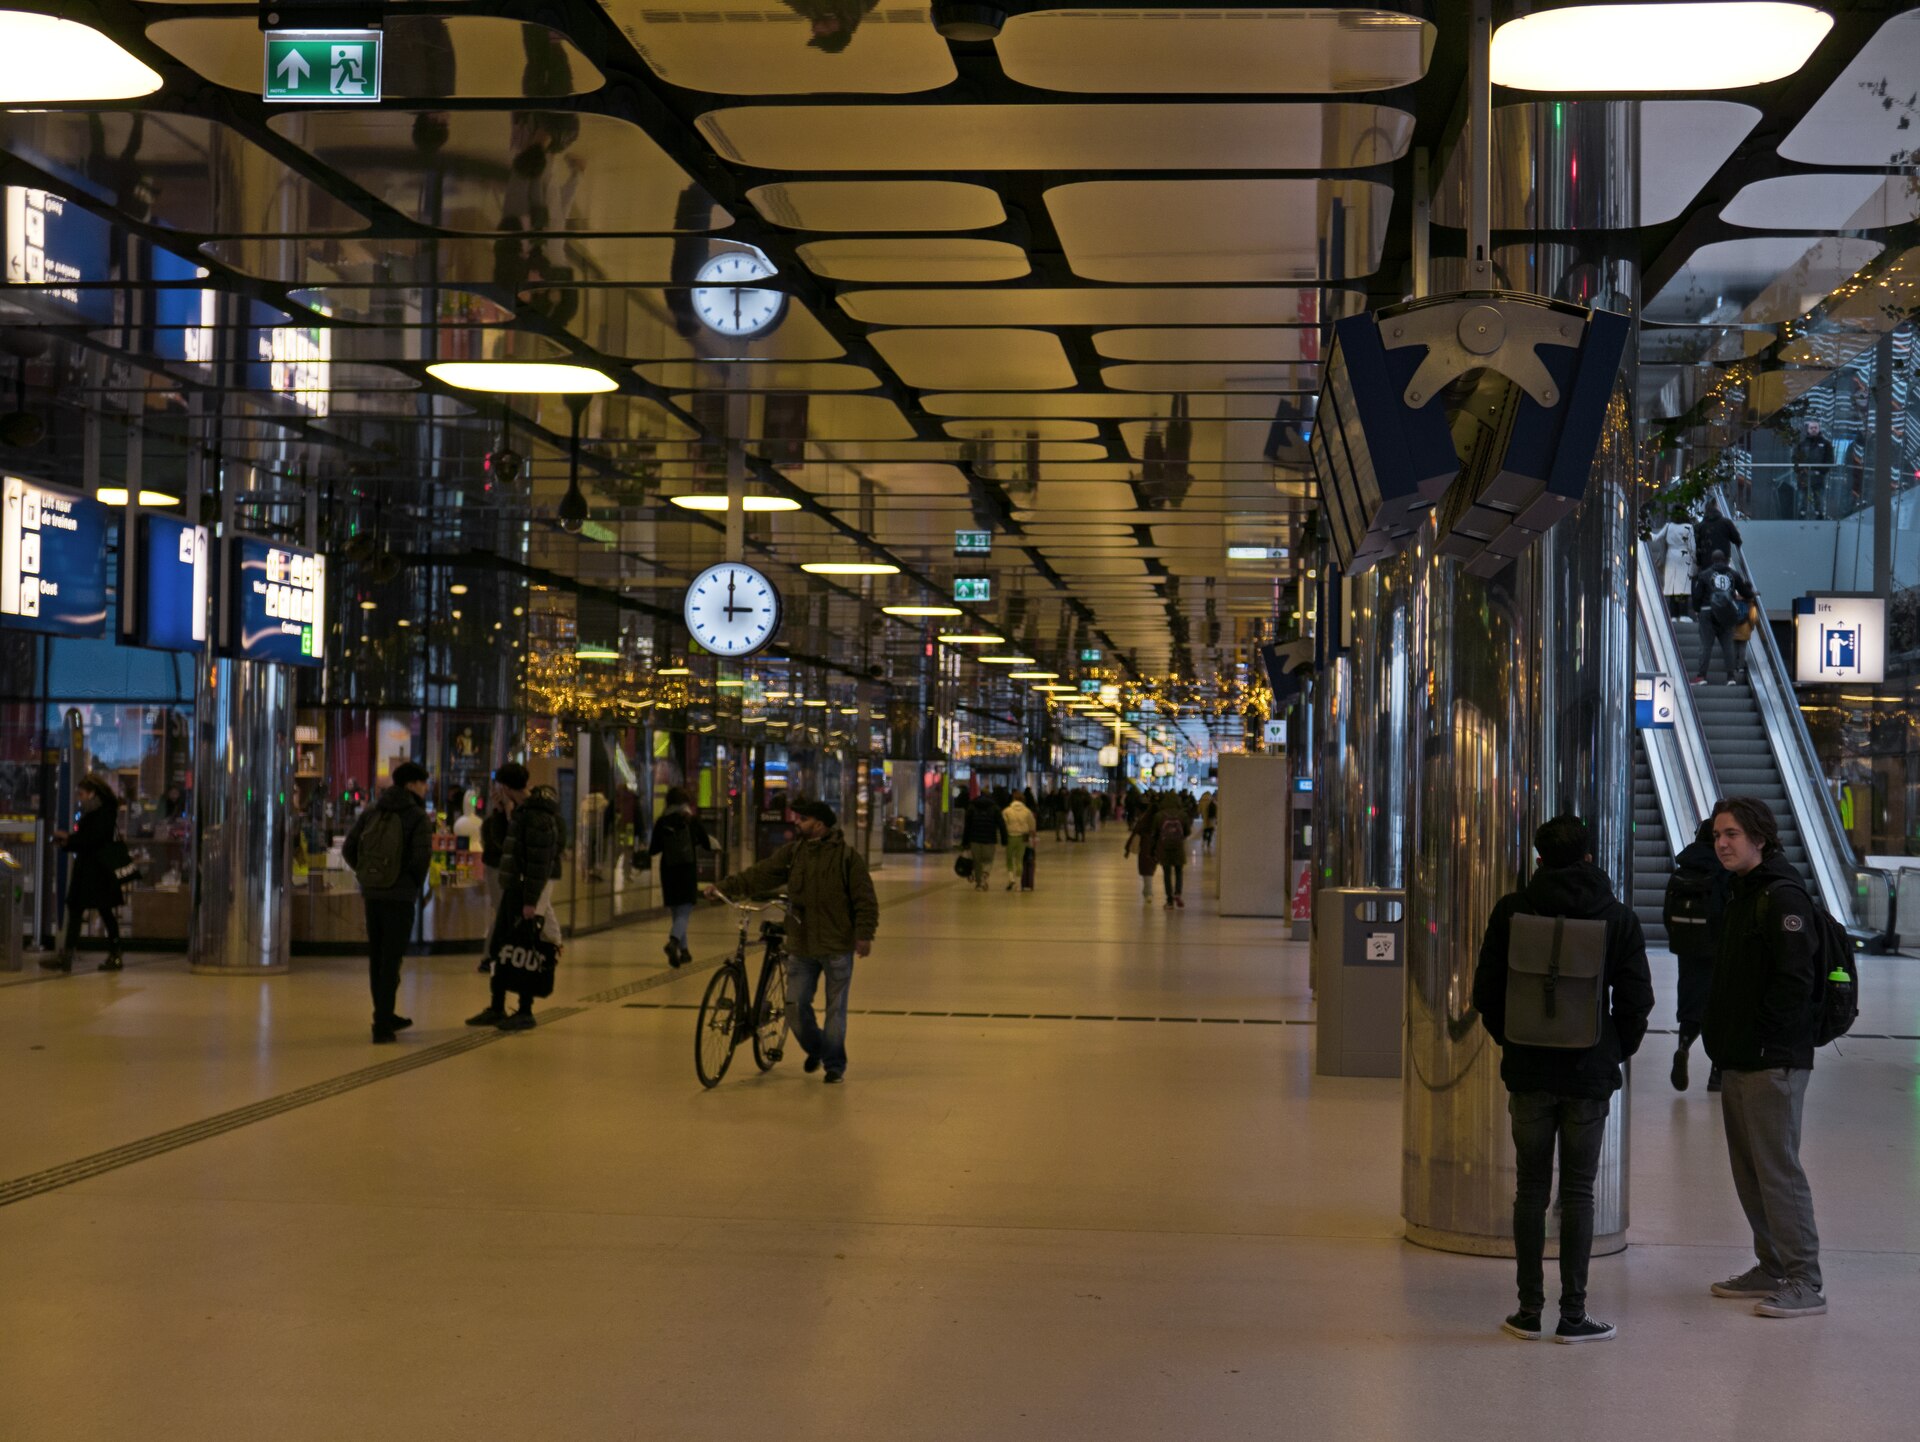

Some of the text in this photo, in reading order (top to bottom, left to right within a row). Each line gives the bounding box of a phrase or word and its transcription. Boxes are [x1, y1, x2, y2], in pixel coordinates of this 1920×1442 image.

[55, 499, 72, 513] naar
[41, 510, 78, 531] de treinen
[41, 580, 58, 596] Oost
[1818, 604, 1832, 612] lift
